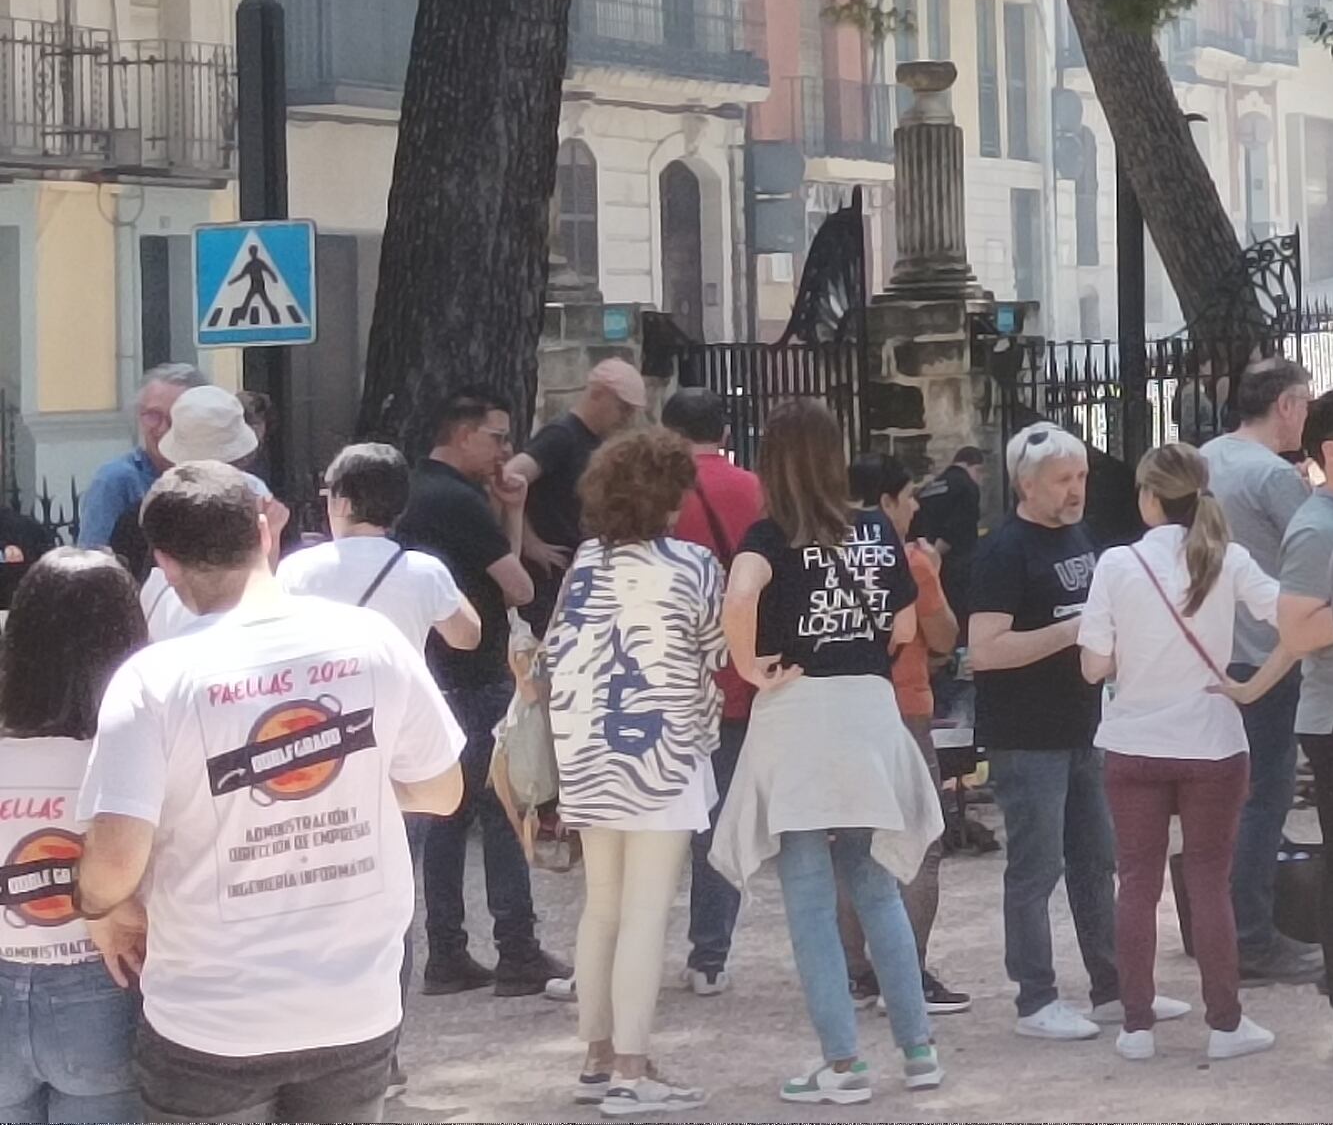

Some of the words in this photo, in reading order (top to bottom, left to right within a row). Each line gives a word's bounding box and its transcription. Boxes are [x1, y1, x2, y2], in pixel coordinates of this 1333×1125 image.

[803, 544, 896, 570] FLWERS
[825, 567, 840, 589] &
[810, 587, 890, 613] SUNET
[207, 669, 293, 707] PAELLAS
[307, 658, 361, 685] 2022
[0, 797, 66, 821] ELLAS
